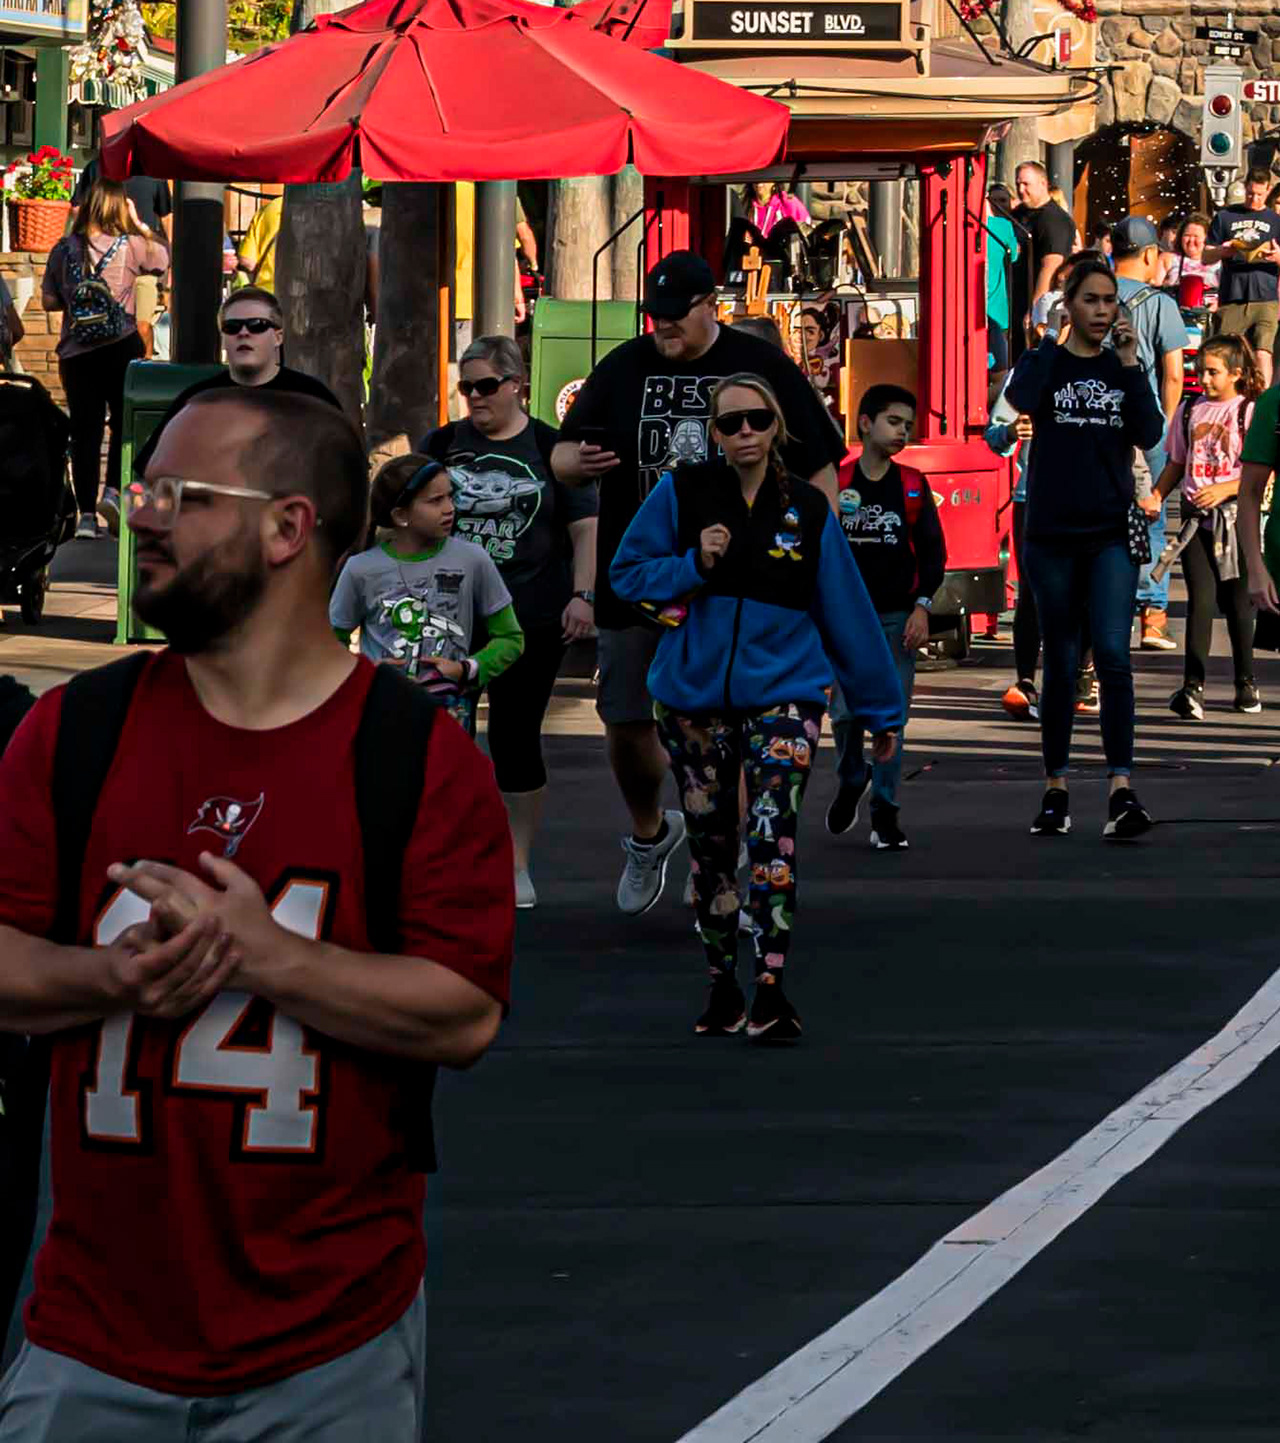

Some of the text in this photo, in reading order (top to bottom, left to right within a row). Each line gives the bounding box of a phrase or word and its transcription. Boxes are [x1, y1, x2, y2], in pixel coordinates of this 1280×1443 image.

[730, 10, 866, 34] SUNSET BLVD.
[84, 877, 330, 1153] 14
